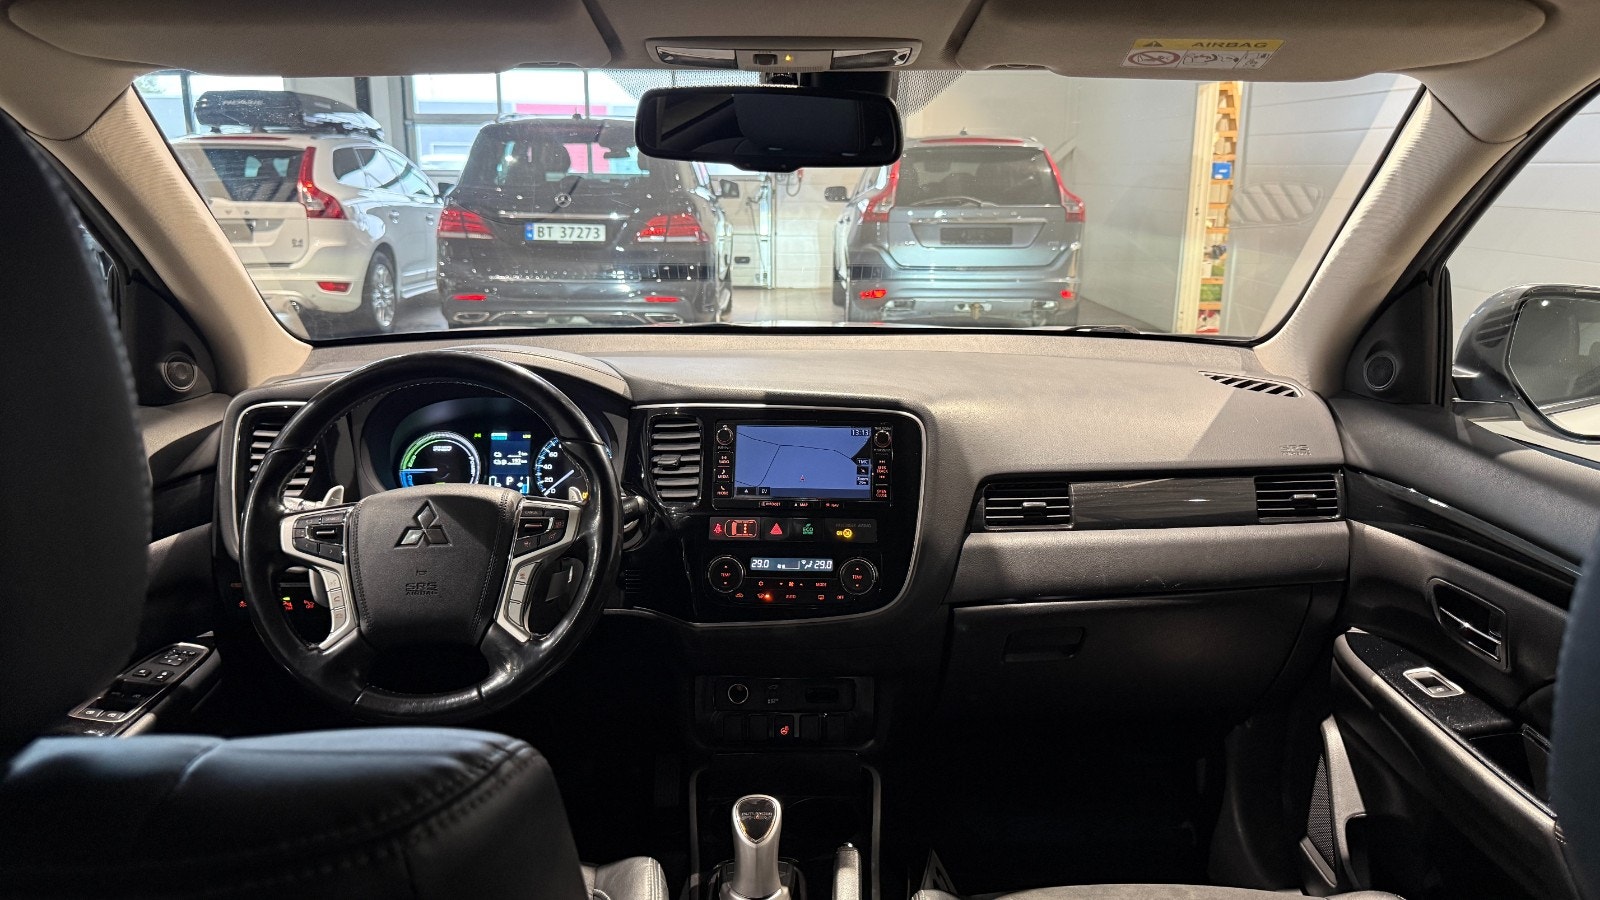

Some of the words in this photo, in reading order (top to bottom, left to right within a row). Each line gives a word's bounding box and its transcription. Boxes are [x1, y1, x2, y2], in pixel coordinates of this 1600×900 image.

[537, 226, 553, 238] BT
[560, 226, 600, 239] 37273
[505, 476, 514, 486] P
[751, 559, 770, 568] 29.0
[814, 560, 833, 569] 29.0
[405, 582, 438, 591] SRS
